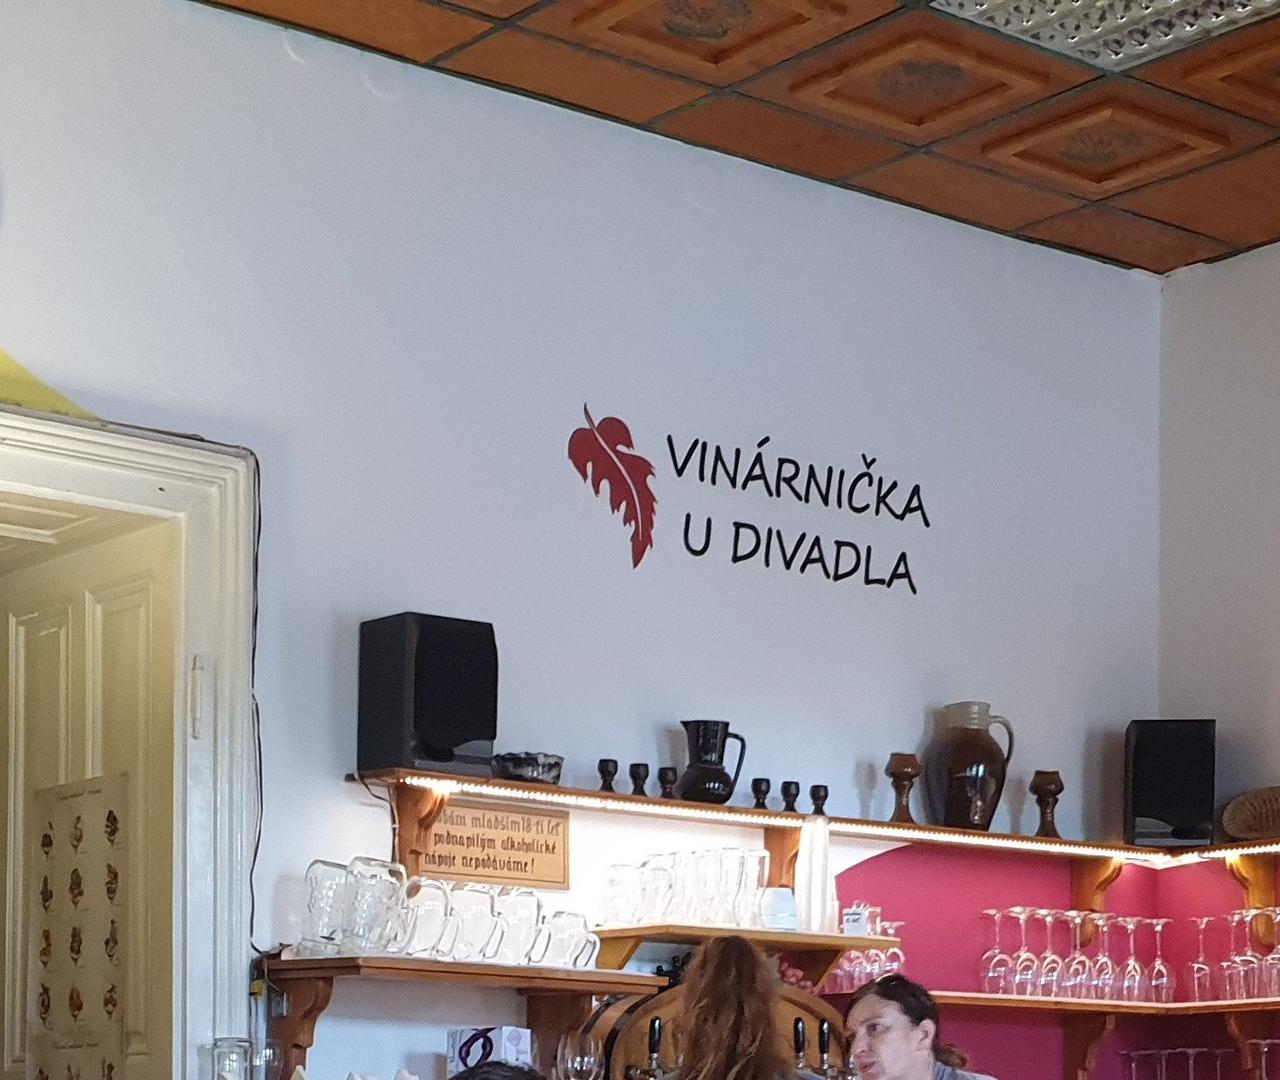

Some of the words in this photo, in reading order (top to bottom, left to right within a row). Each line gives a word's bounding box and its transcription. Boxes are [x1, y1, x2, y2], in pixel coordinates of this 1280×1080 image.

[667, 434, 931, 528] VINÁRNIČKA
[683, 513, 712, 557] U
[732, 521, 918, 596] DIVADLA
[424, 852, 456, 868] nápoje
[434, 830, 496, 852] podnapilým
[500, 835, 556, 855] alkoholické
